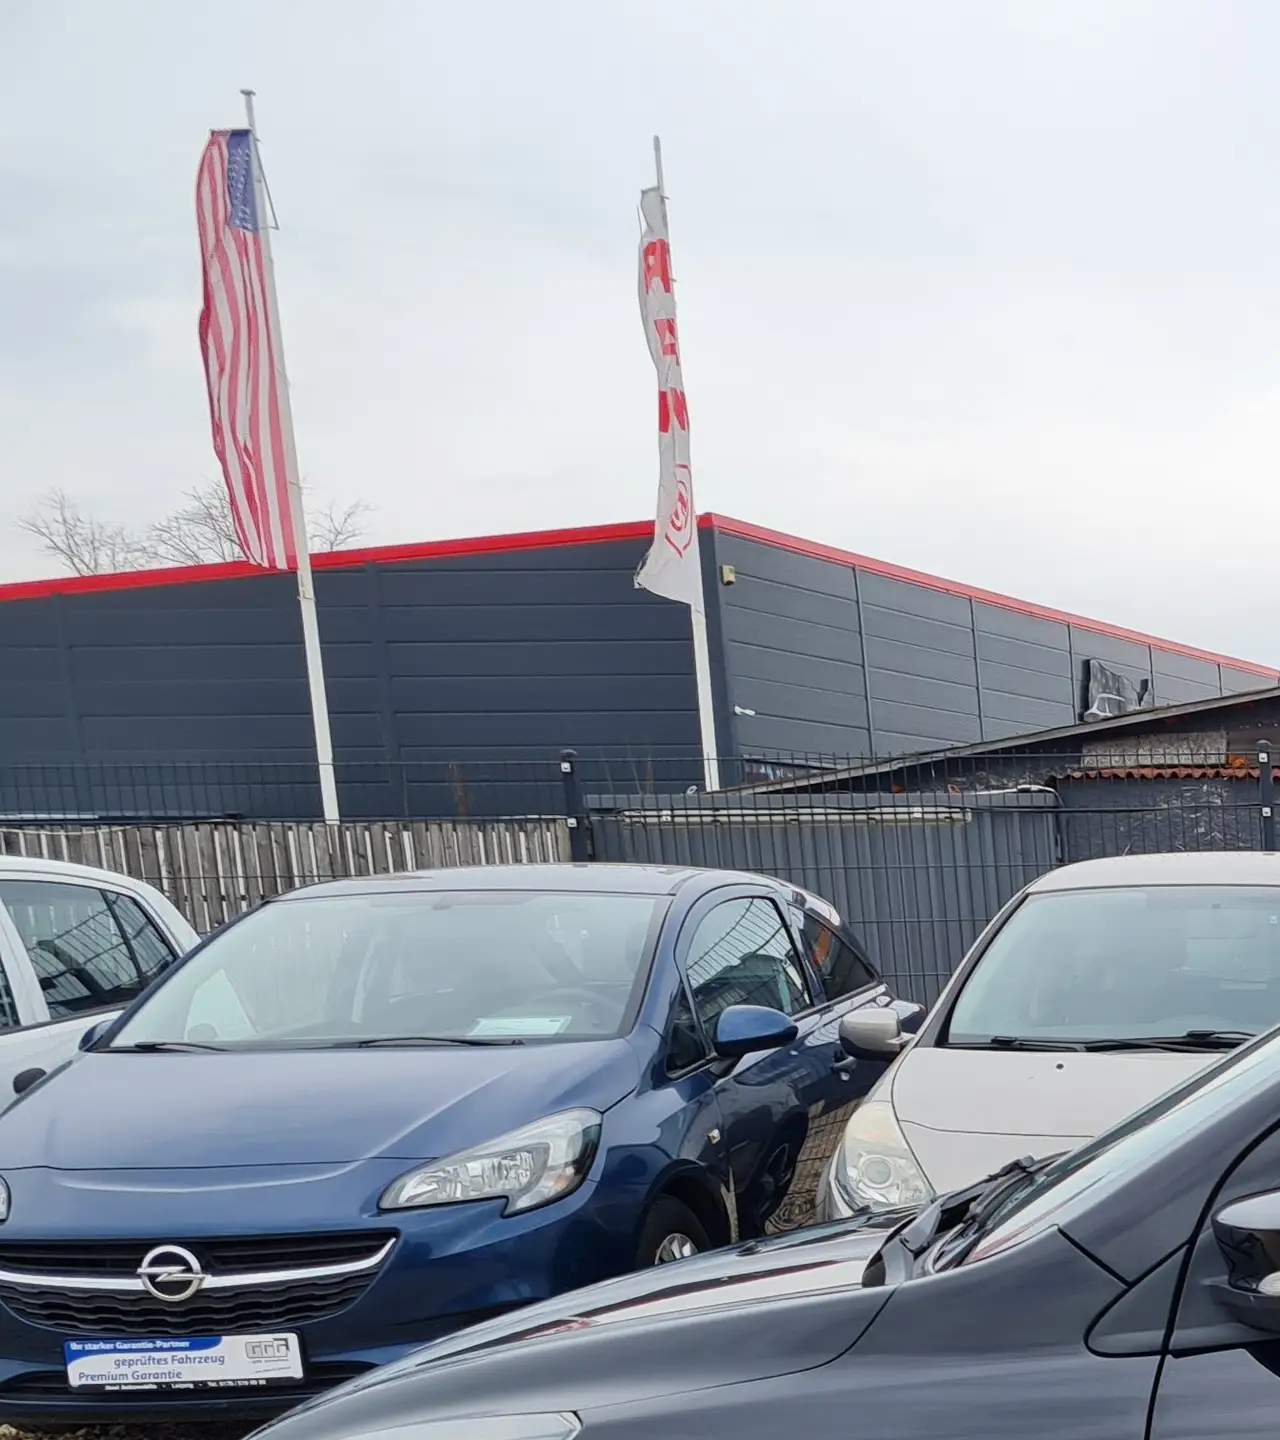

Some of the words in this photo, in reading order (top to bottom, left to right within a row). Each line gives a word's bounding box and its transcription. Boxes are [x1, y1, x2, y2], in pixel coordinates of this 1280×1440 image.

[114, 1354, 168, 1369] geprüftes
[171, 1353, 225, 1366] Fahrzeug
[79, 1371, 128, 1382] Premium
[131, 1369, 183, 1381] Garantie
